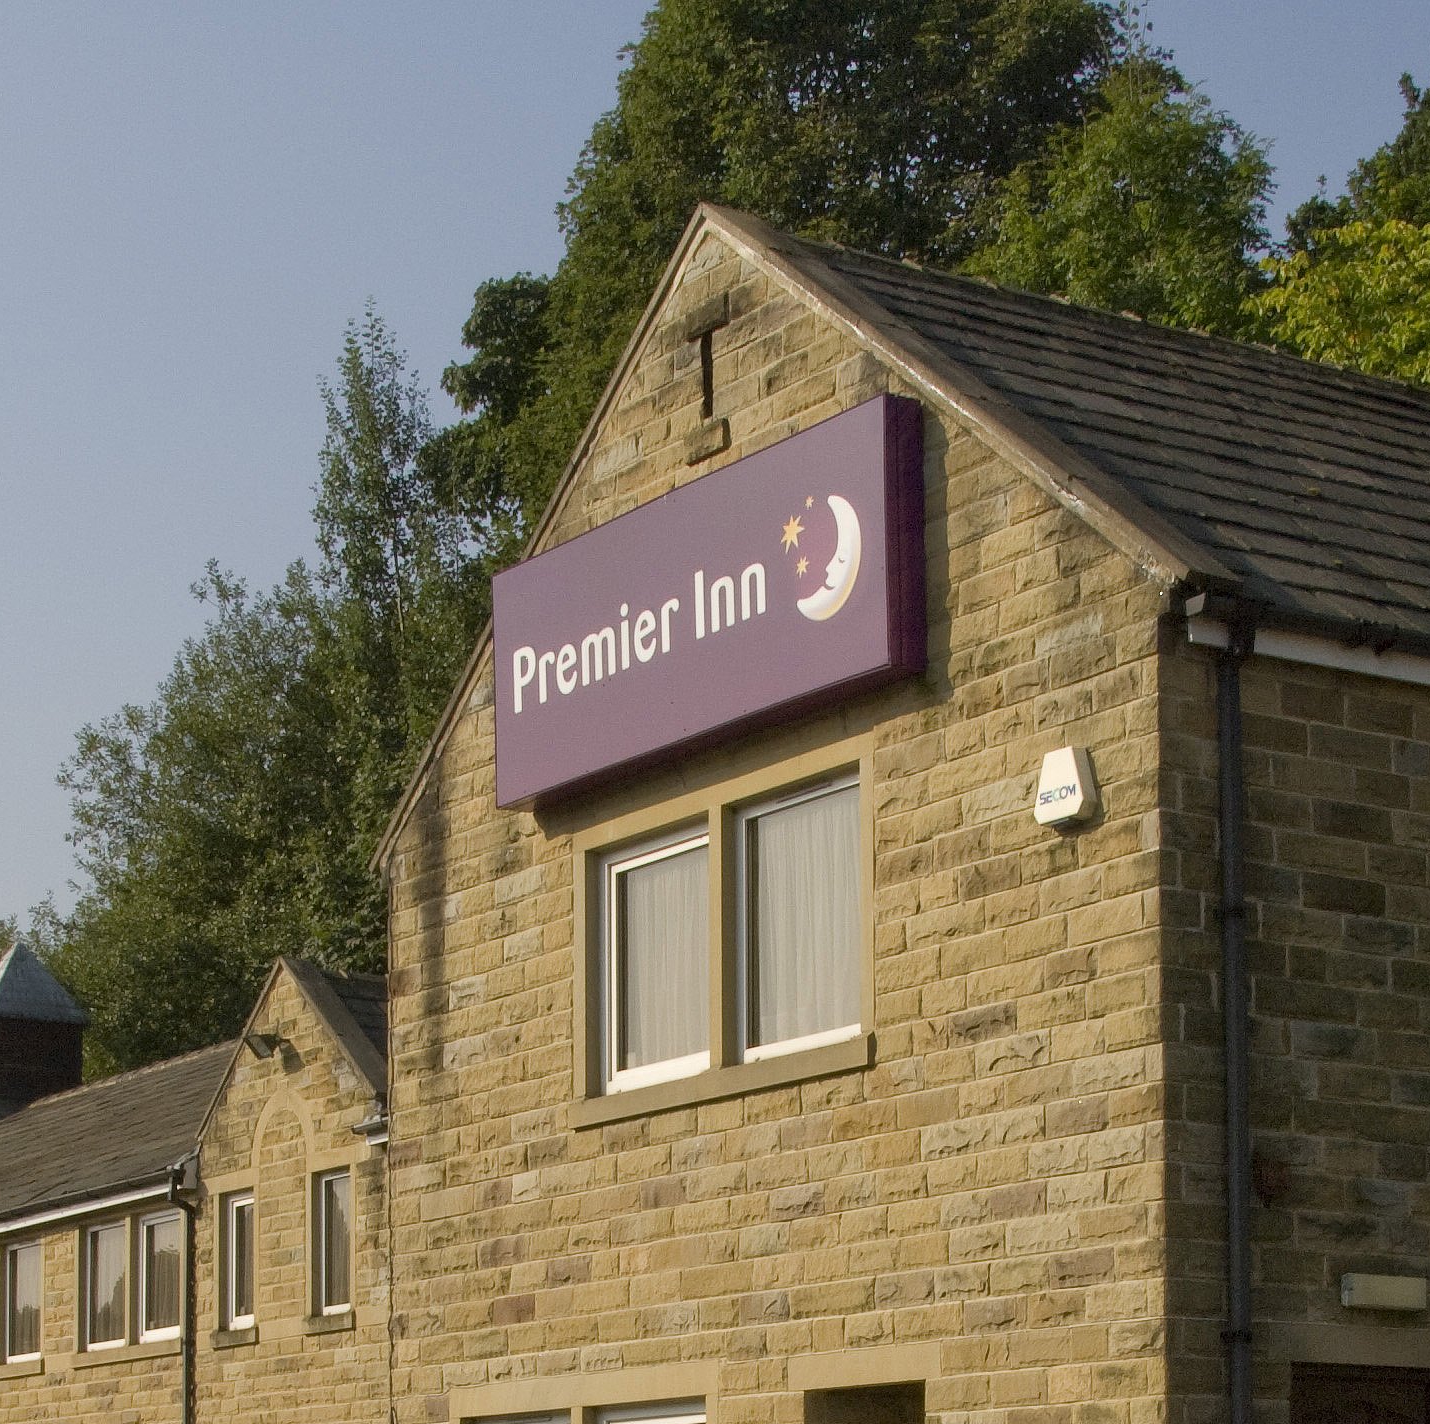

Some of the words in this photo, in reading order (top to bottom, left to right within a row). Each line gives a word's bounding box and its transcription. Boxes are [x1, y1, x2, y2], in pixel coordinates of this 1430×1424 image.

[512, 598, 679, 714] Premier
[693, 562, 767, 640] Inn
[1039, 784, 1077, 806] SECOM
